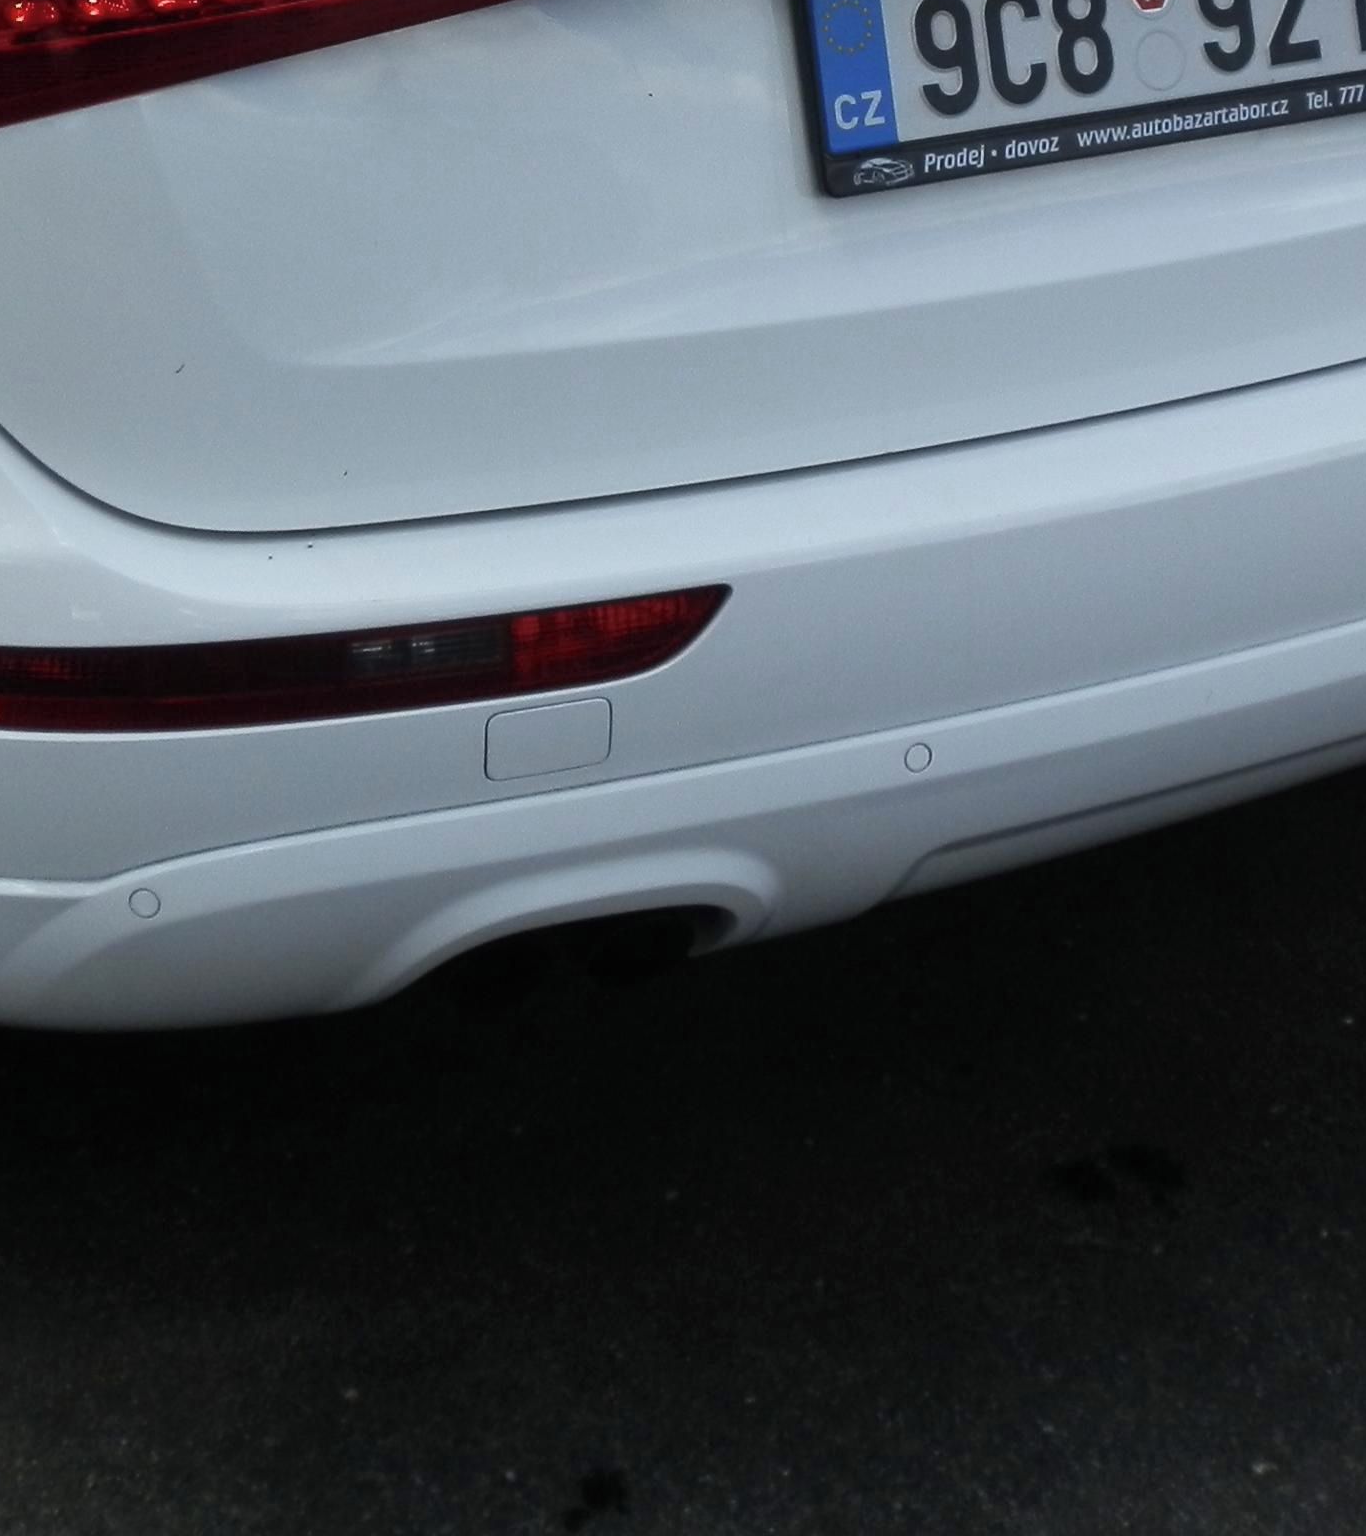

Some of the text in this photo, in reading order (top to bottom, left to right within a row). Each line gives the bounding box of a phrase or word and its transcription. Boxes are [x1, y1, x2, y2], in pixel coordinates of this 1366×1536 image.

[834, 89, 886, 131] CZ
[924, 144, 986, 174] Prodej
[1004, 135, 1060, 161] dovoz
[1076, 98, 1290, 148] www.autobazartabor.cz
[1306, 91, 1333, 111] Tel.
[1338, 83, 1366, 106] 777
